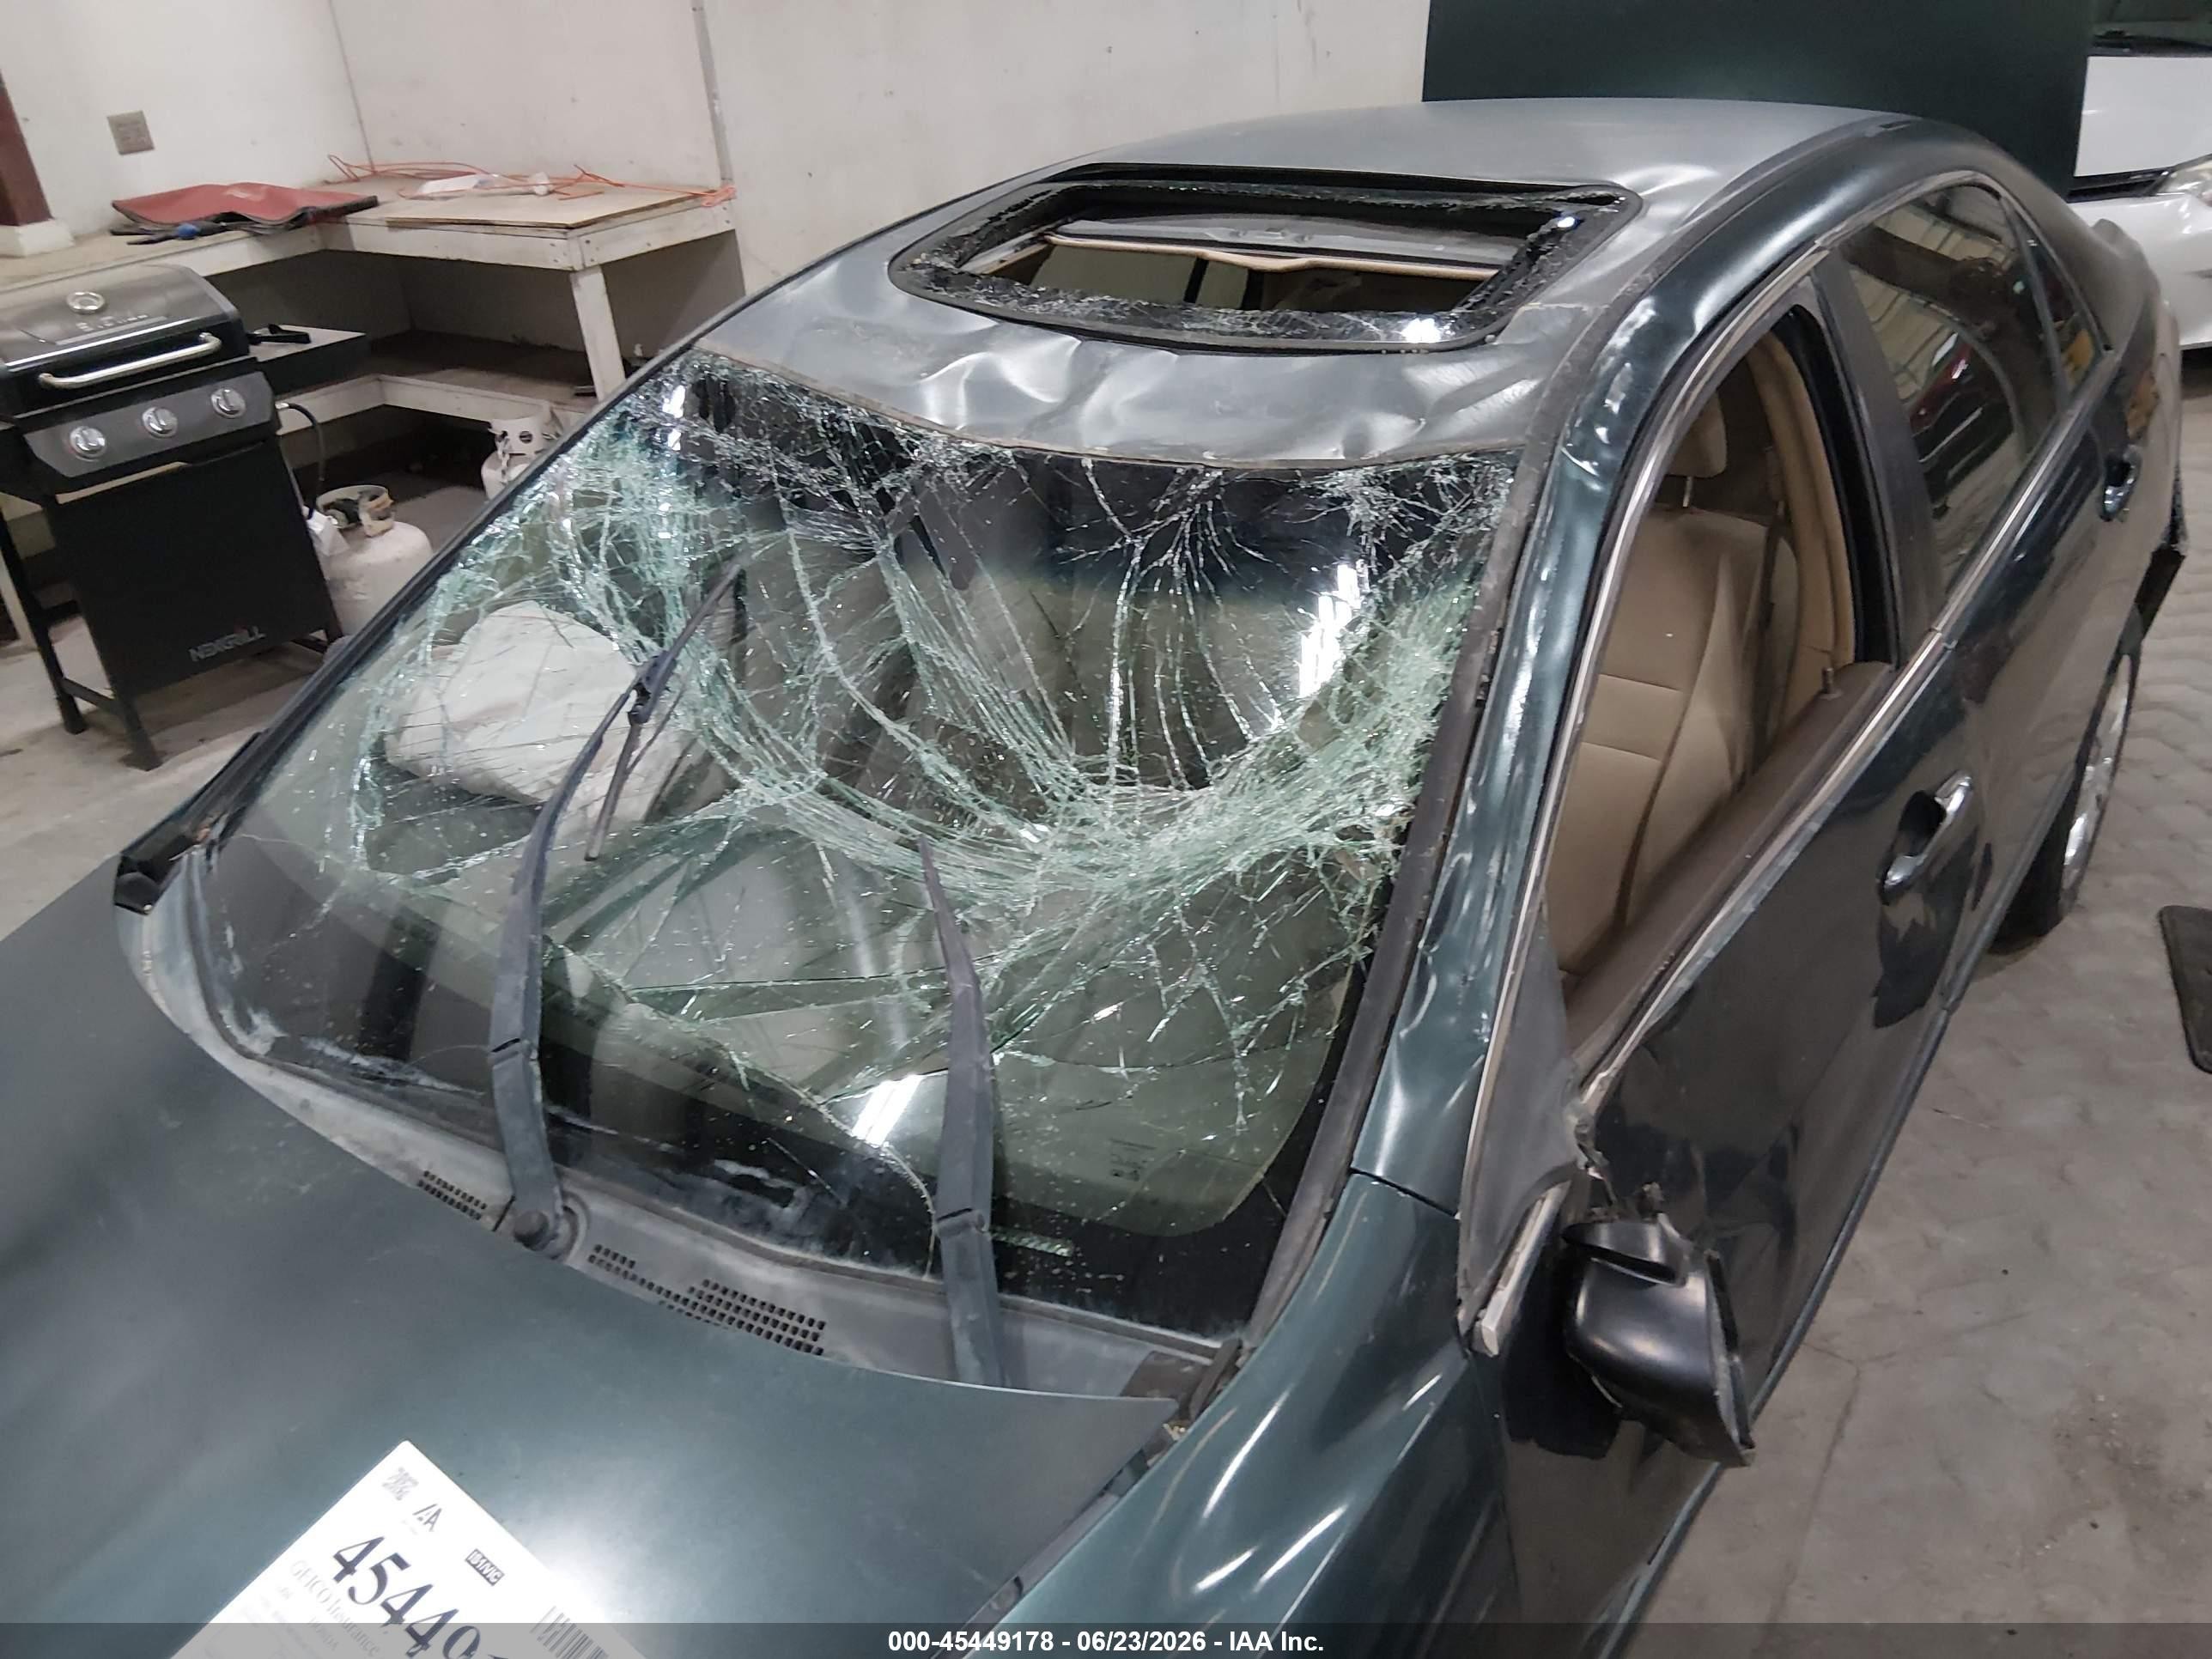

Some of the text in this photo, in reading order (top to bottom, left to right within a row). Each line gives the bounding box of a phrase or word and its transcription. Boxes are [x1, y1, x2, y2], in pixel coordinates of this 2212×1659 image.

[290, 1560, 333, 1605] GEICO
[326, 1598, 380, 1657] Insurance
[331, 1535, 510, 1659] 45449
